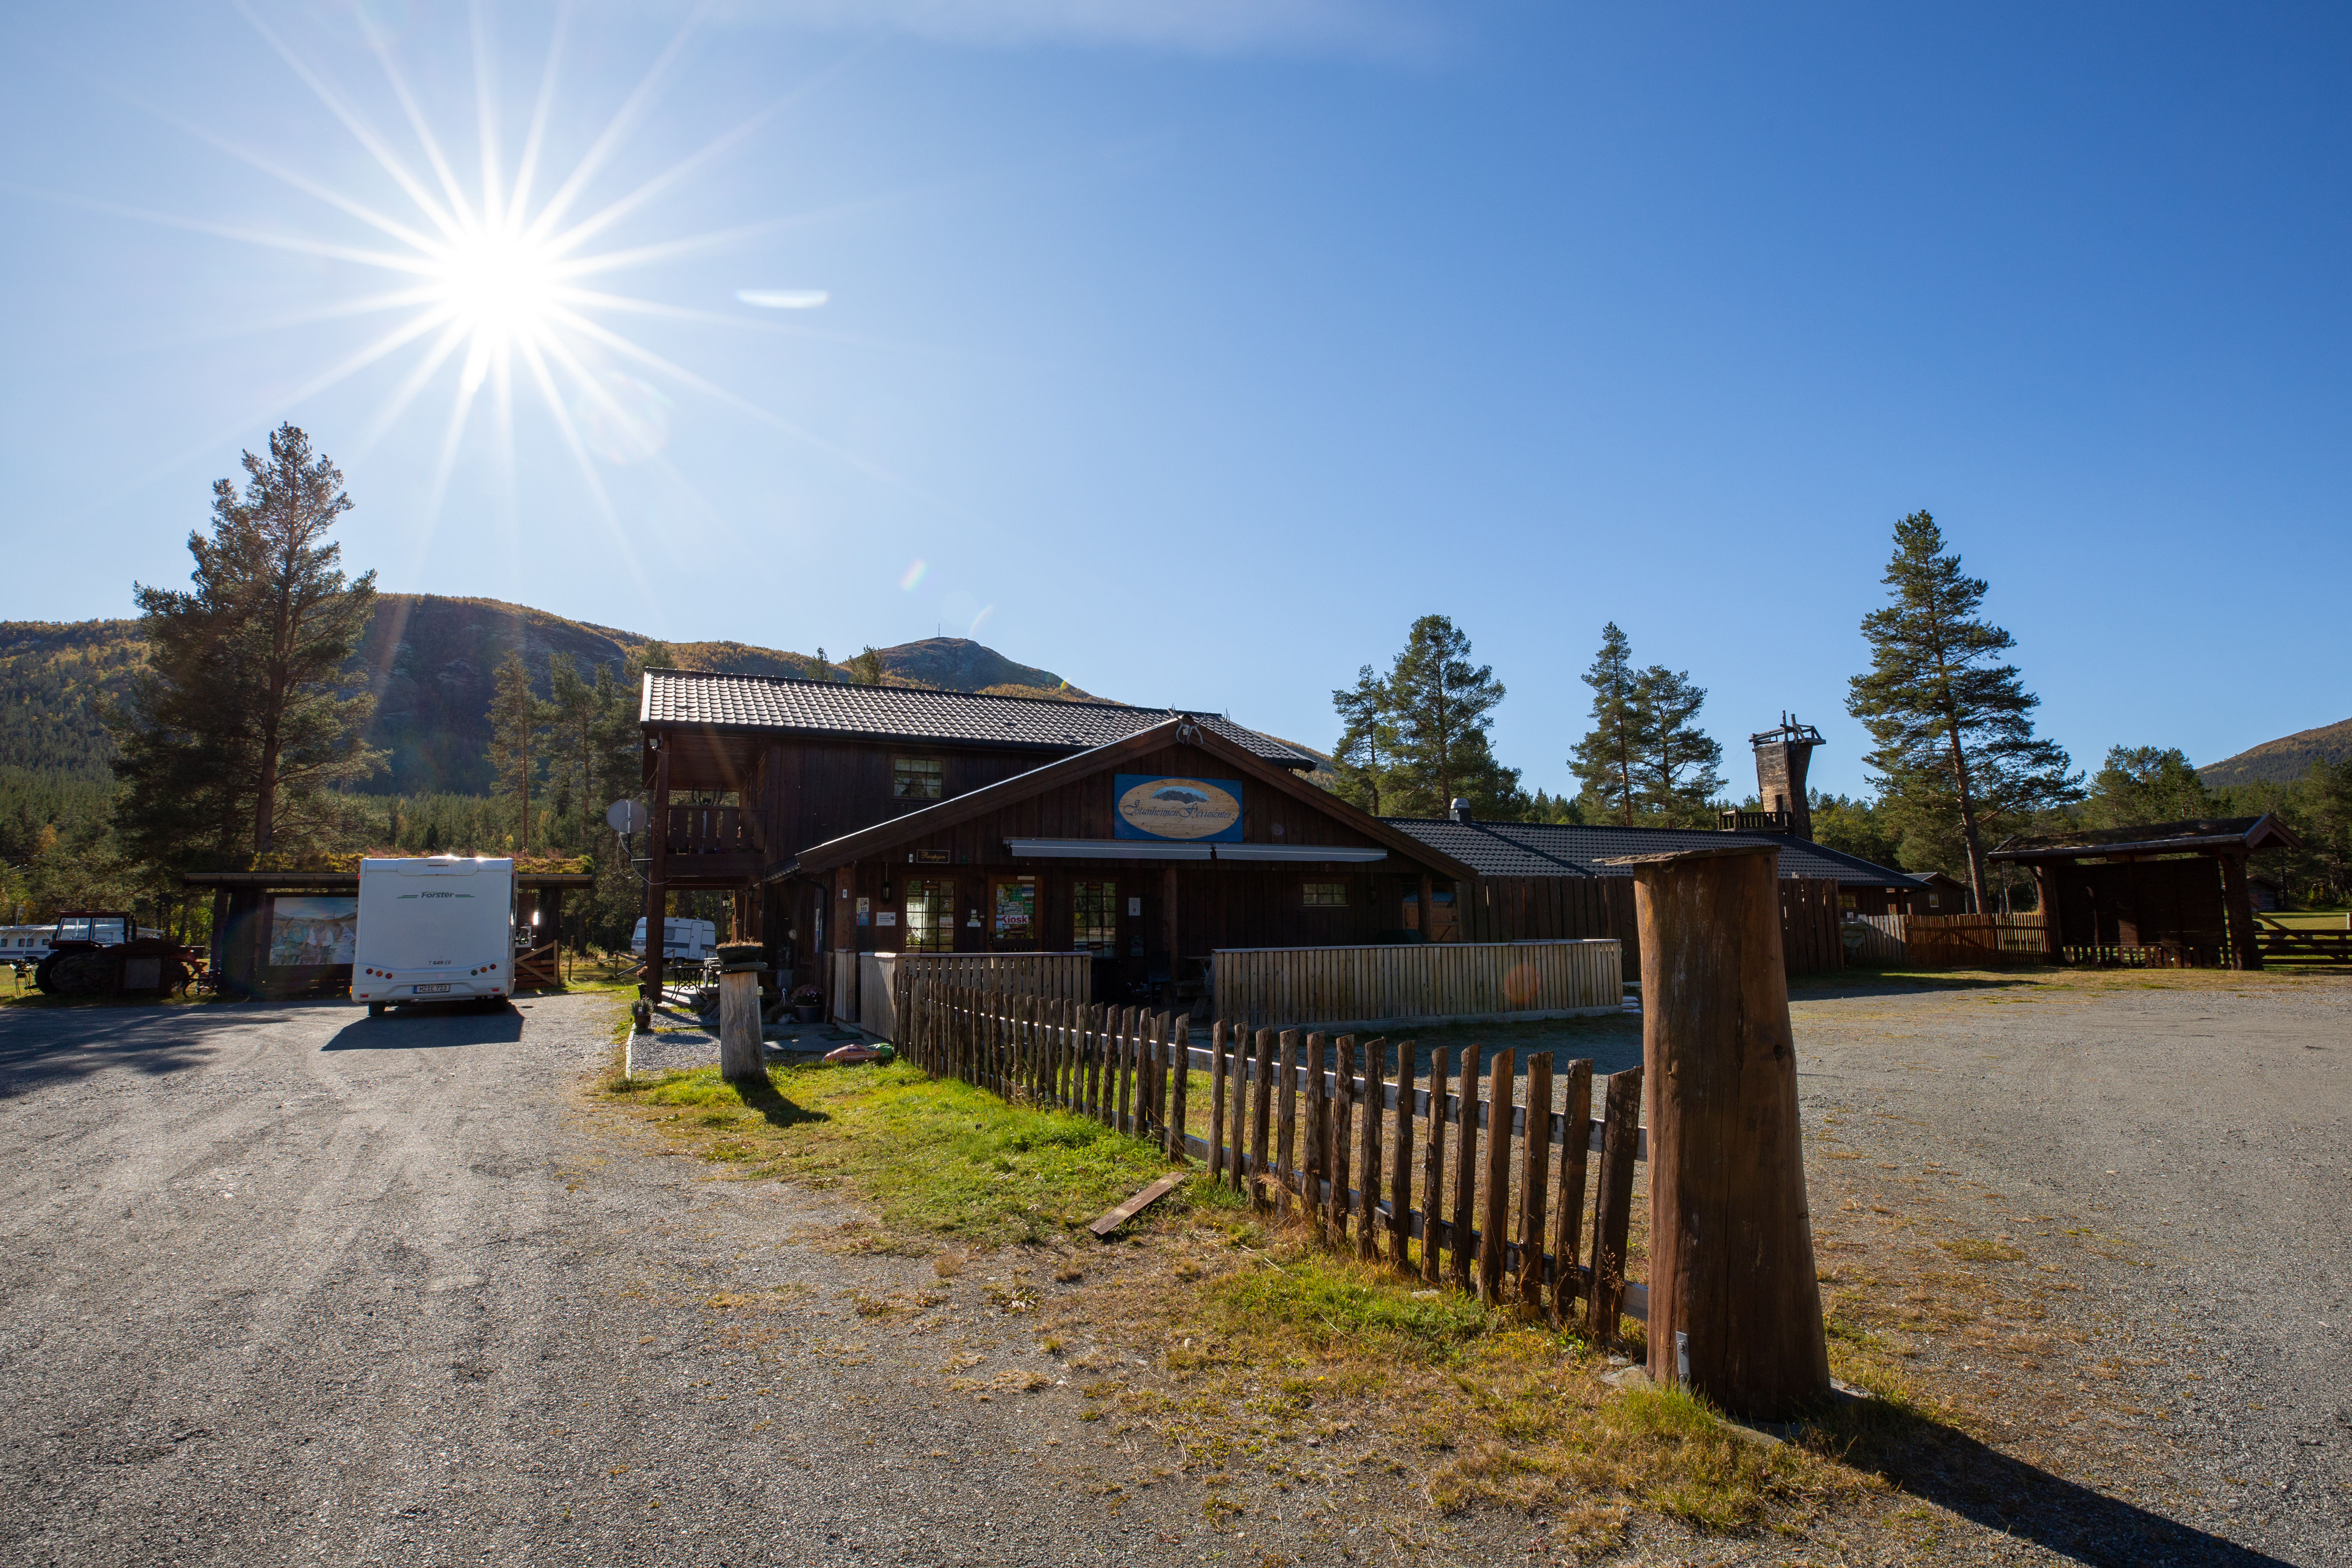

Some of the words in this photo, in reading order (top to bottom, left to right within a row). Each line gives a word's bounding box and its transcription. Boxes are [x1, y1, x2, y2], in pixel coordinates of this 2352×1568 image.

[1123, 800, 1179, 817] Jotunheimen
[1179, 803, 1232, 819] Feriesenter
[921, 851, 946, 861] Resepsjon
